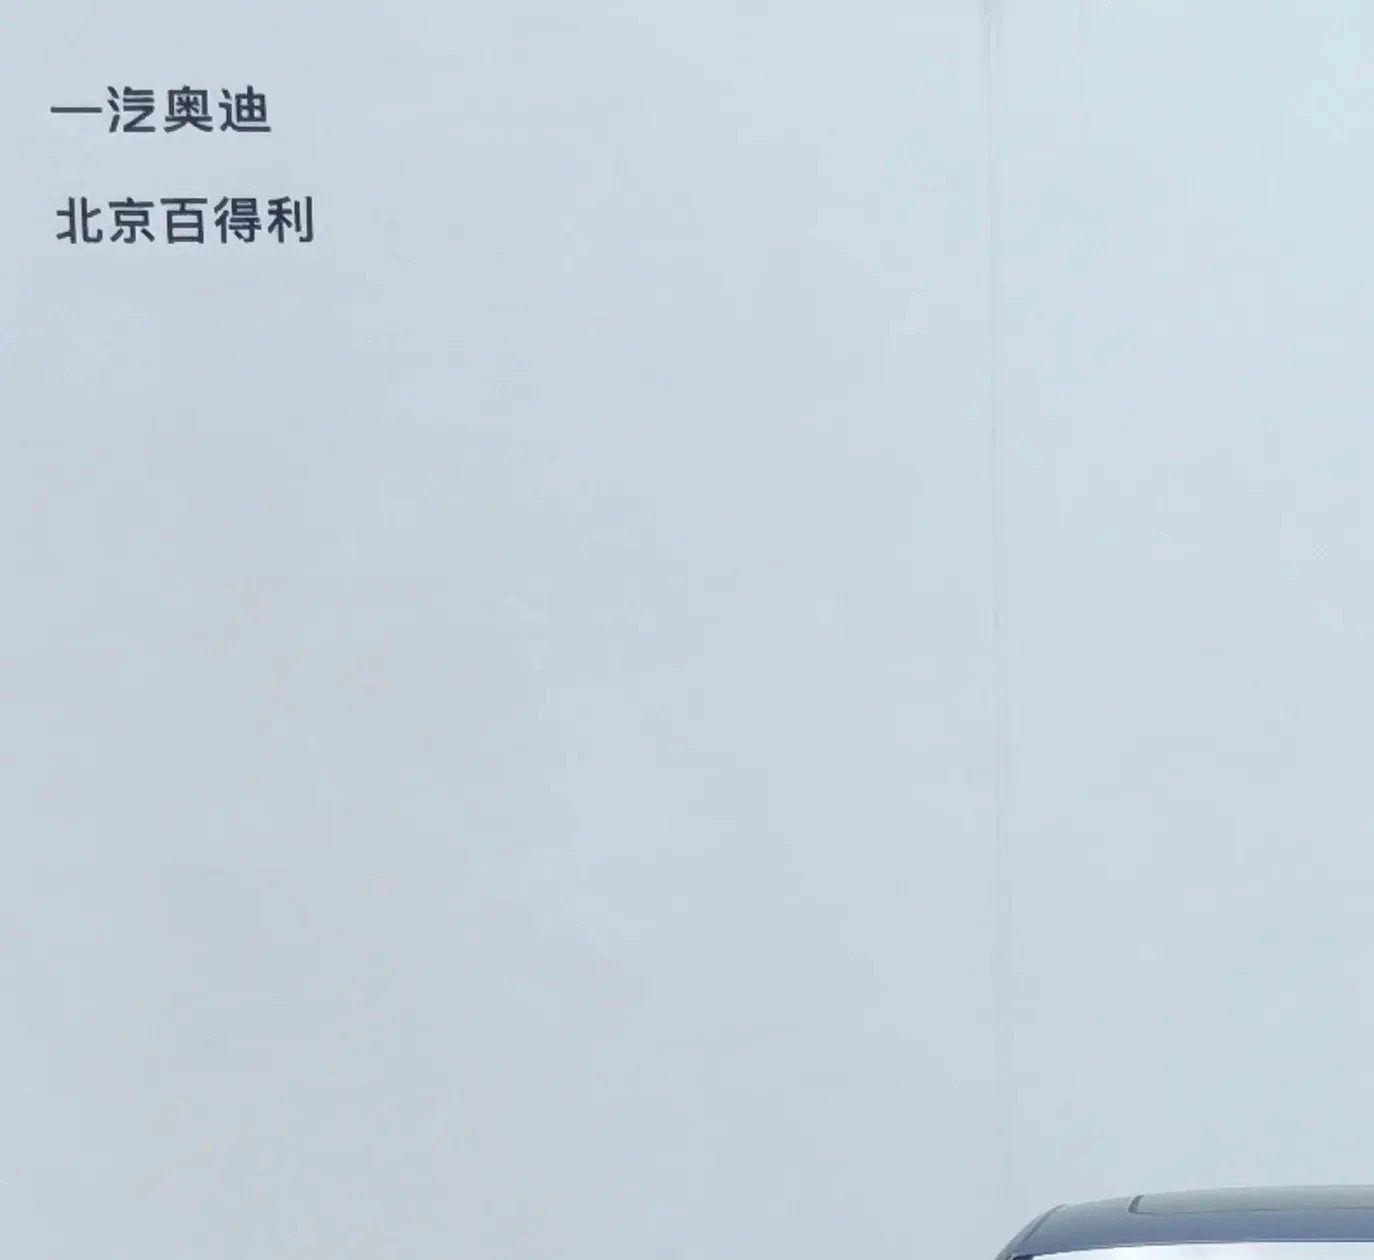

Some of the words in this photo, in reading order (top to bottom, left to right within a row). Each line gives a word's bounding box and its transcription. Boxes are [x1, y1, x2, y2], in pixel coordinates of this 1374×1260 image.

[50, 84, 272, 133] 一汽奥迪
[55, 195, 316, 244] 北京百得利
